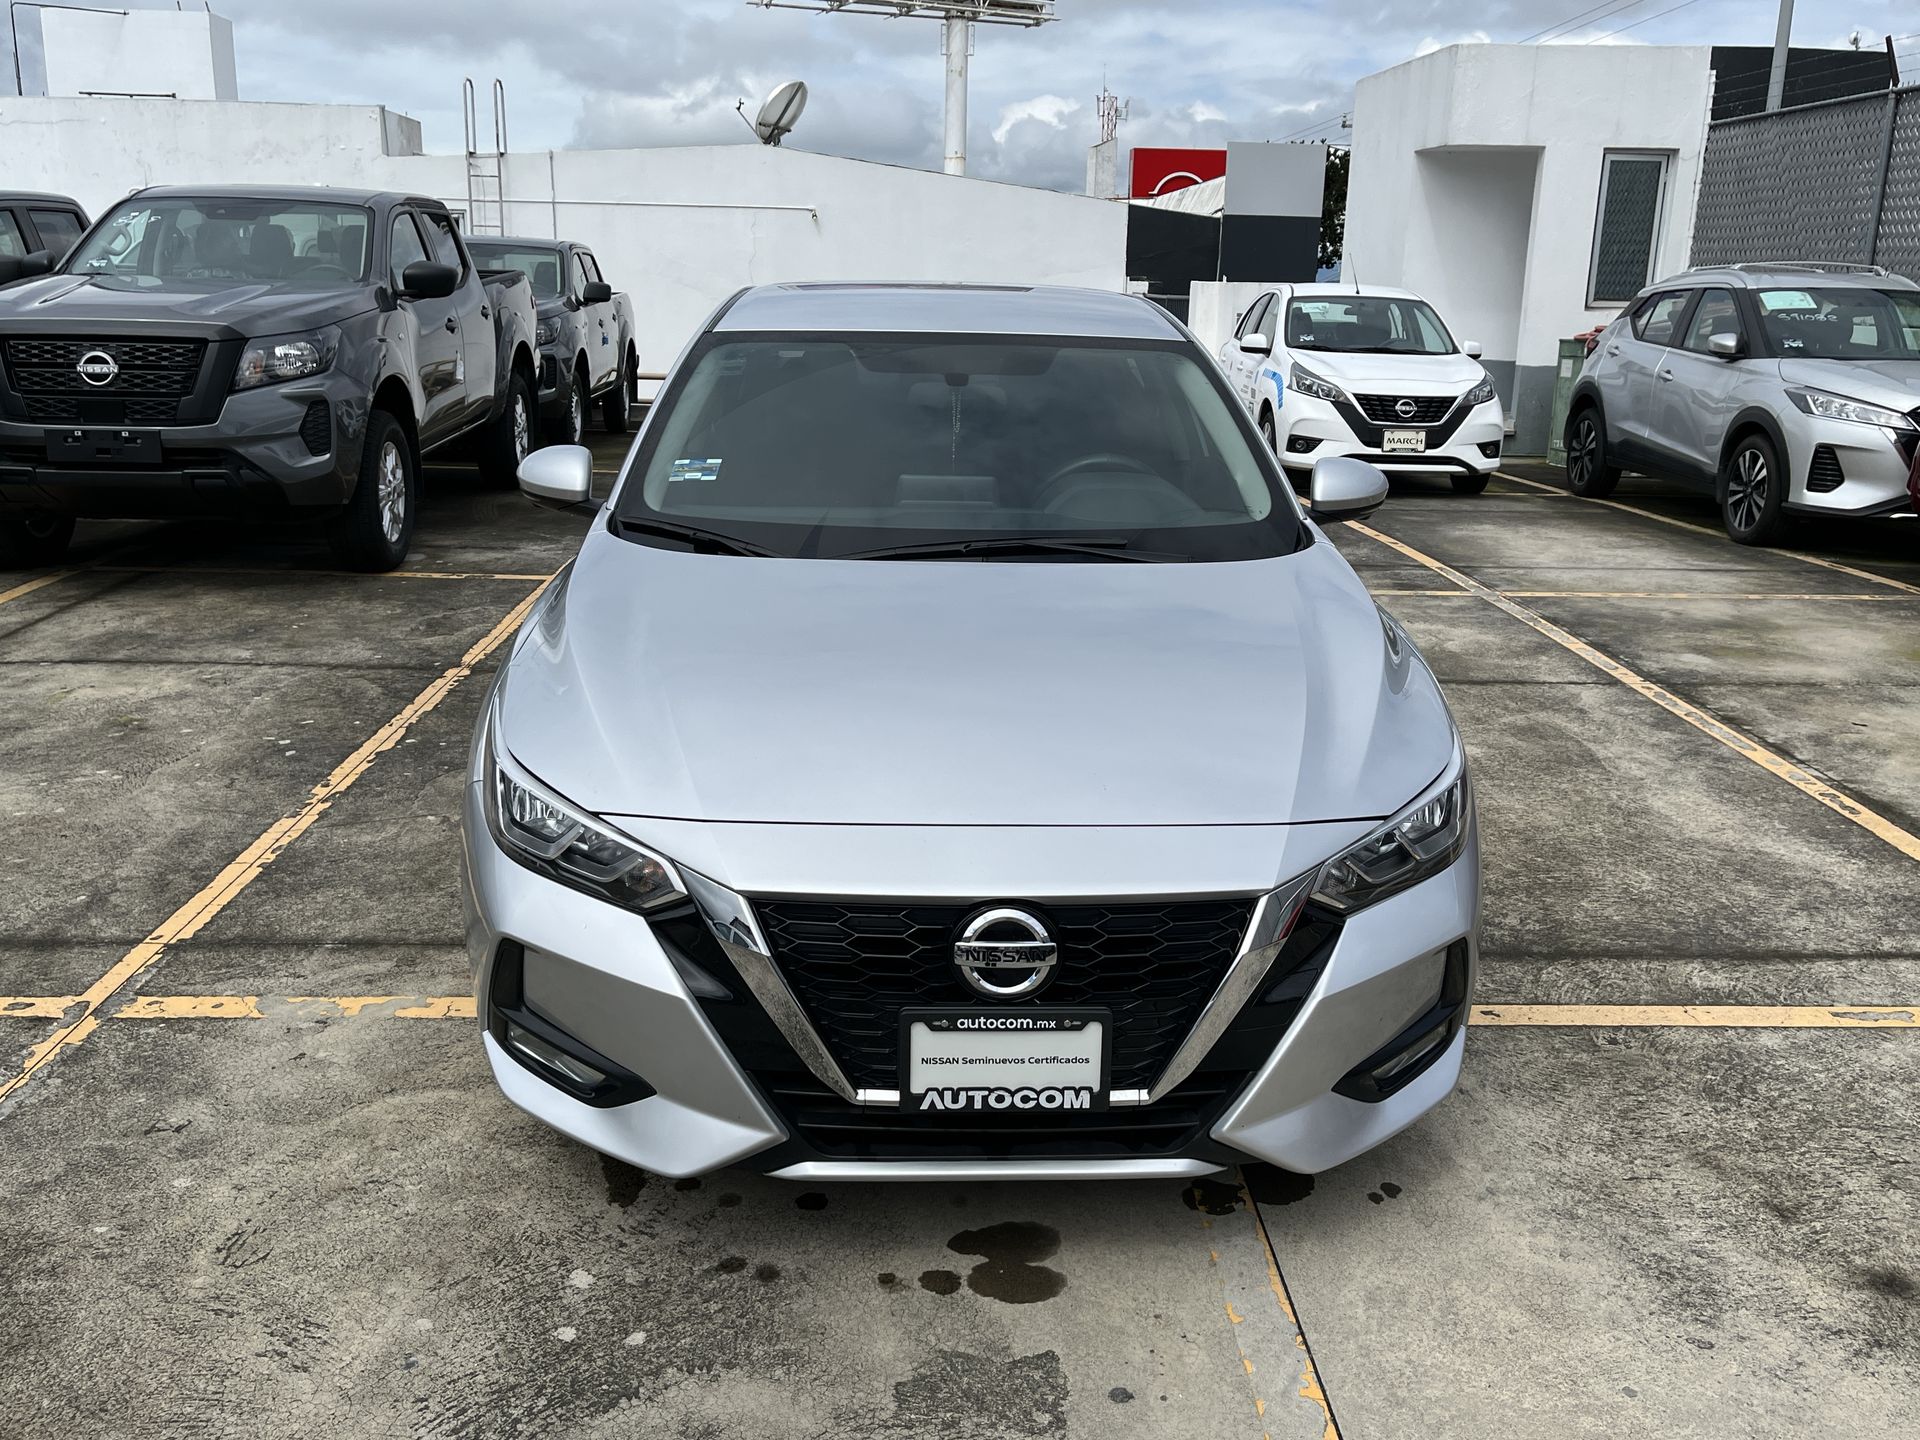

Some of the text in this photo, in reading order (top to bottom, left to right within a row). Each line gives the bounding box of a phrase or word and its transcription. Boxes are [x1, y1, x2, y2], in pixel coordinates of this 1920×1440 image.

[1386, 437, 1423, 445] MARCH
[965, 949, 1048, 963] NISSAN
[957, 1016, 1057, 1029] autocom.mx
[921, 1055, 1090, 1065] NISSAN Seminuevos Certificados
[919, 1089, 1091, 1110] AUTOCOM
